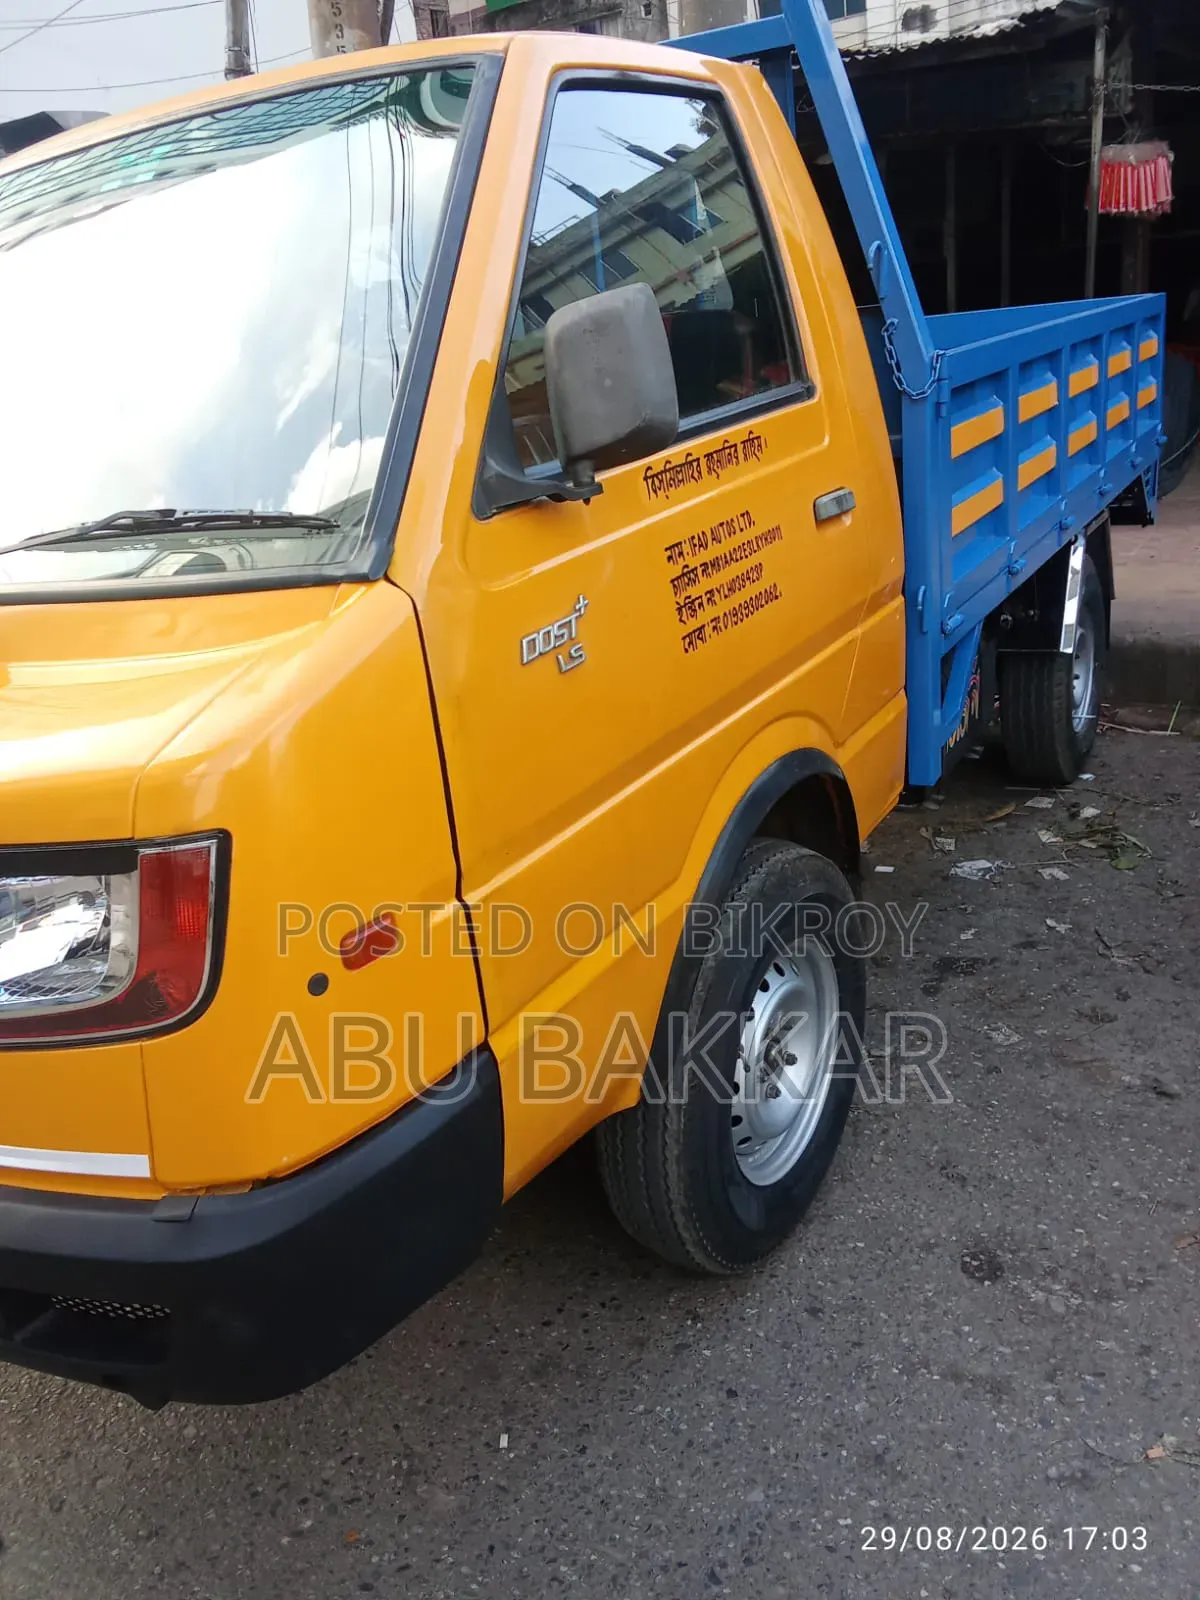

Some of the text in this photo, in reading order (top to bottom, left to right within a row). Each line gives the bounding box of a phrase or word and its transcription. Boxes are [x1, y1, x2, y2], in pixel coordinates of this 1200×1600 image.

[710, 517, 737, 546] AUTOS
[736, 509, 756, 533] LTD.
[555, 643, 586, 674] LS
